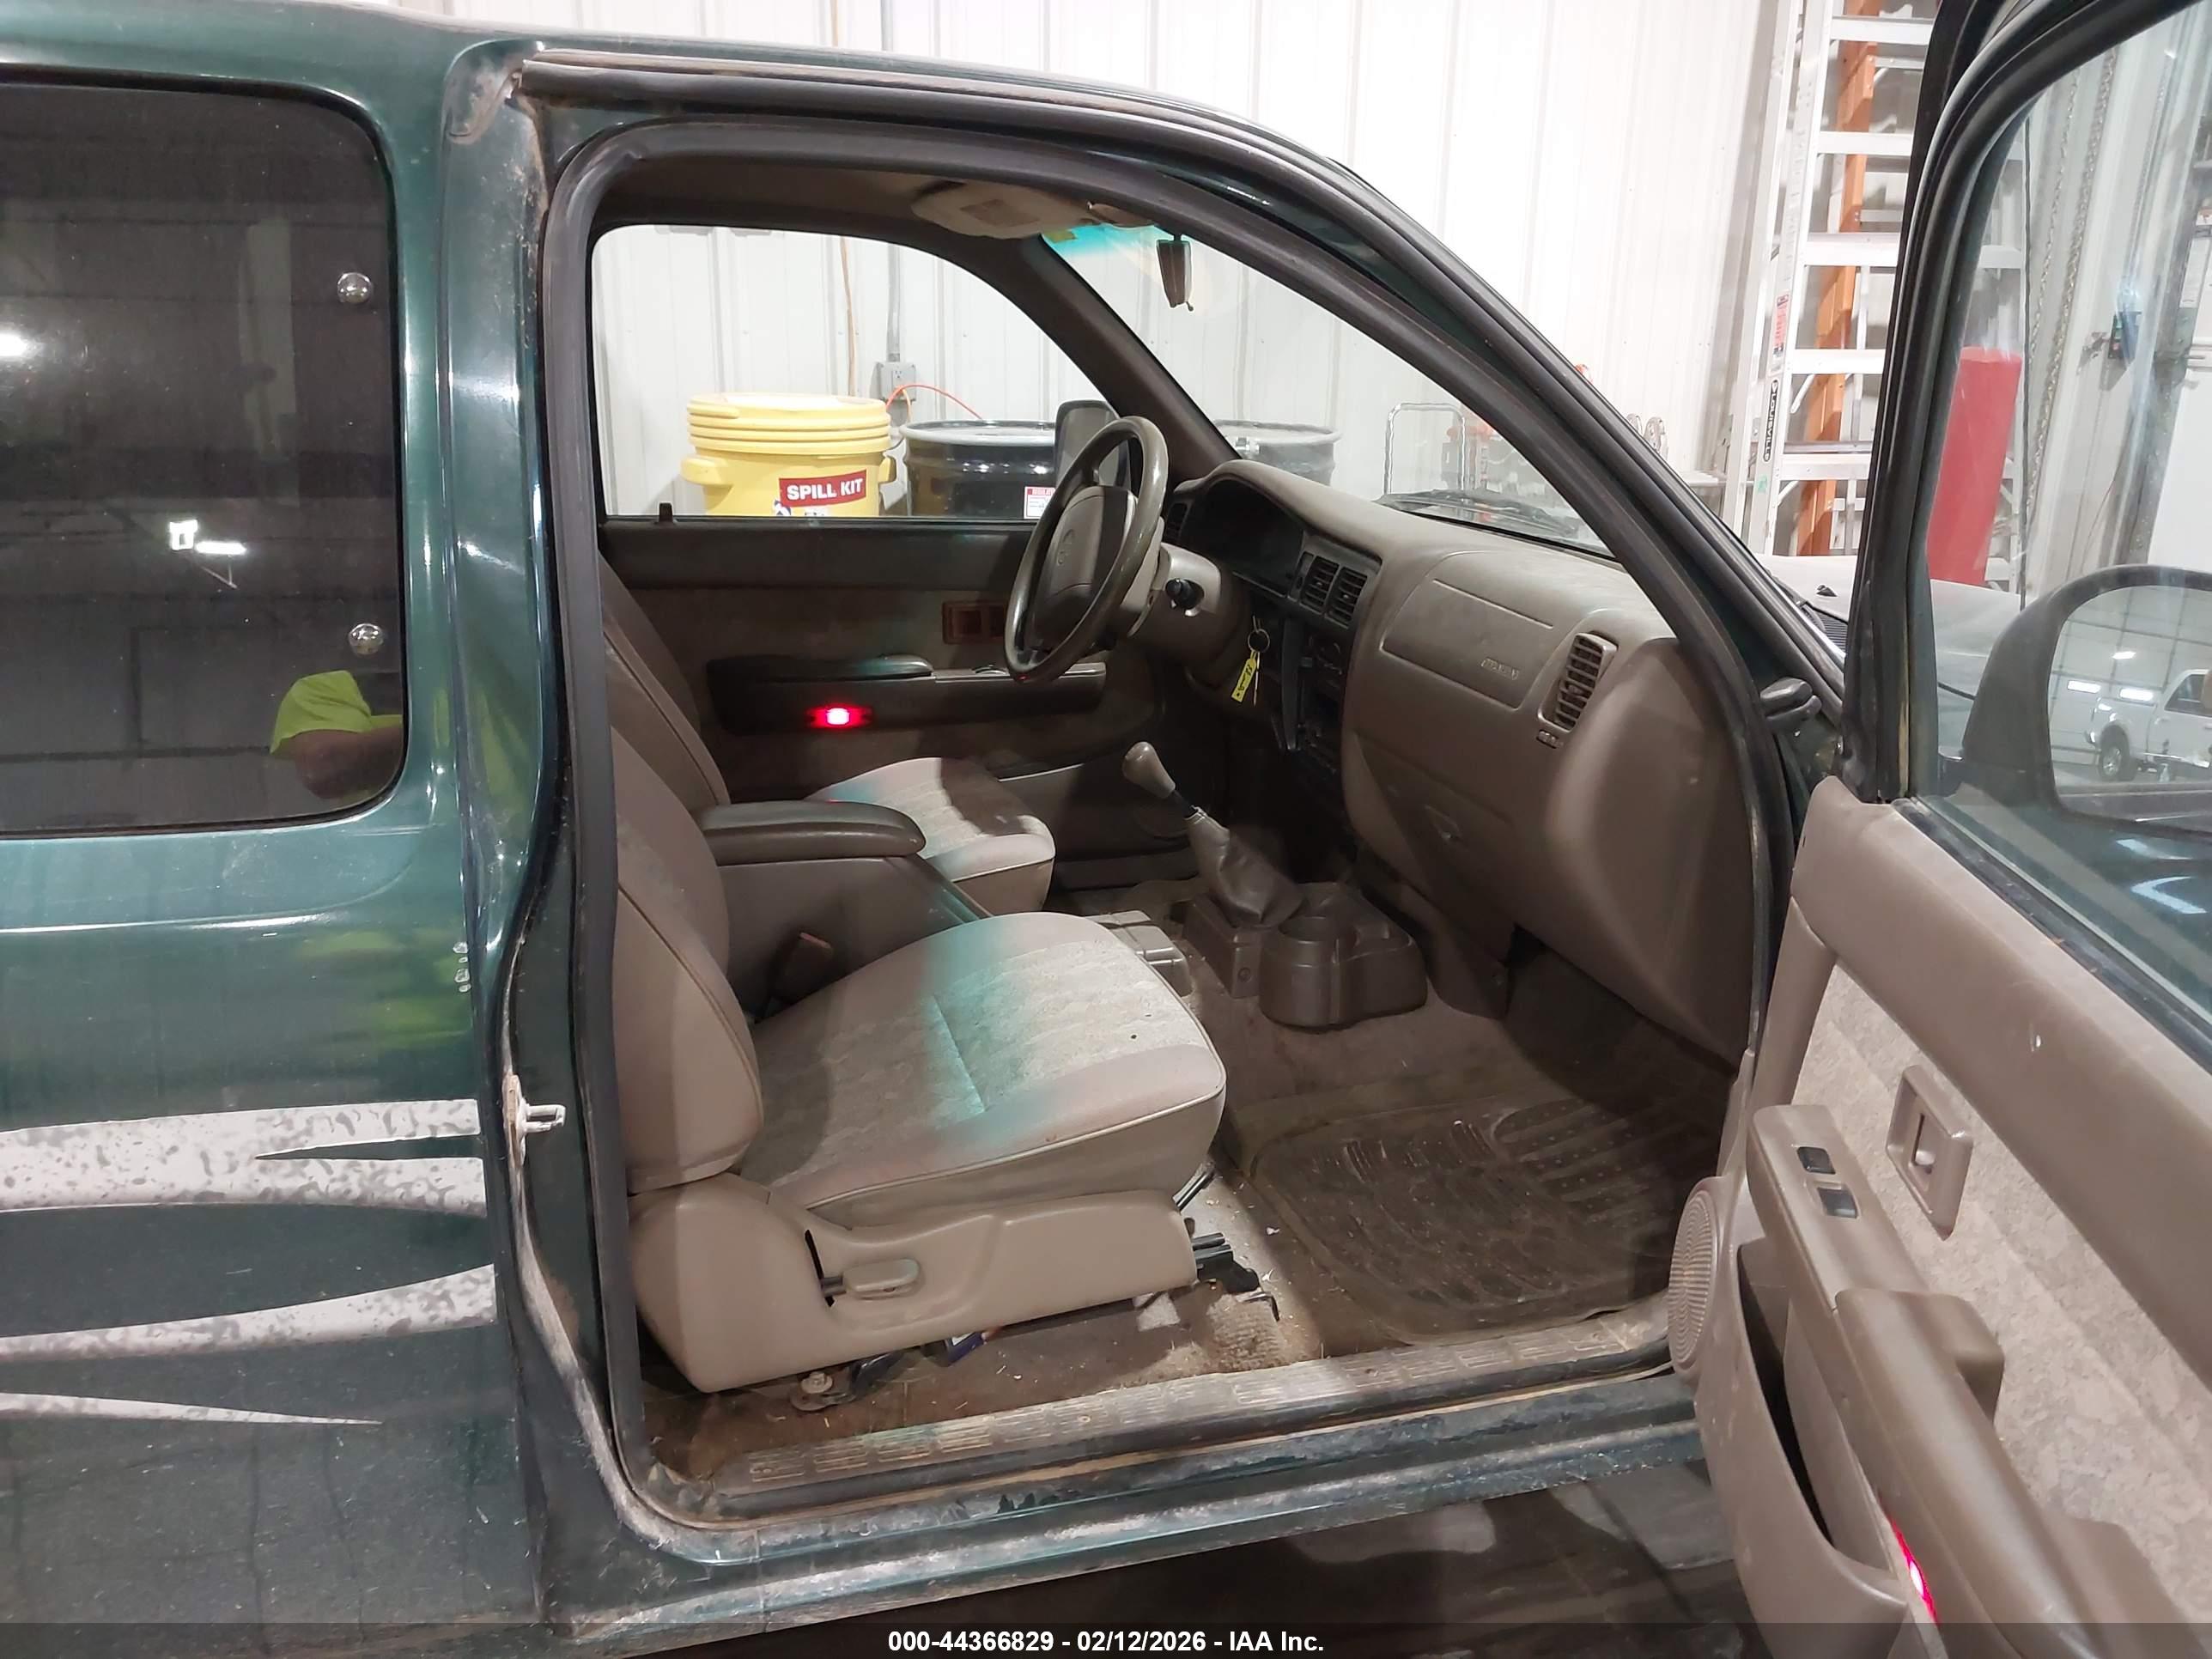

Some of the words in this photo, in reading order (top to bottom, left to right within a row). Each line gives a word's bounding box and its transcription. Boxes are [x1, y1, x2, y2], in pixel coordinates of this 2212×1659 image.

[1764, 392, 1777, 461] LOUISVILLE
[787, 483, 837, 500] SPILL
[841, 478, 863, 495] KIT
